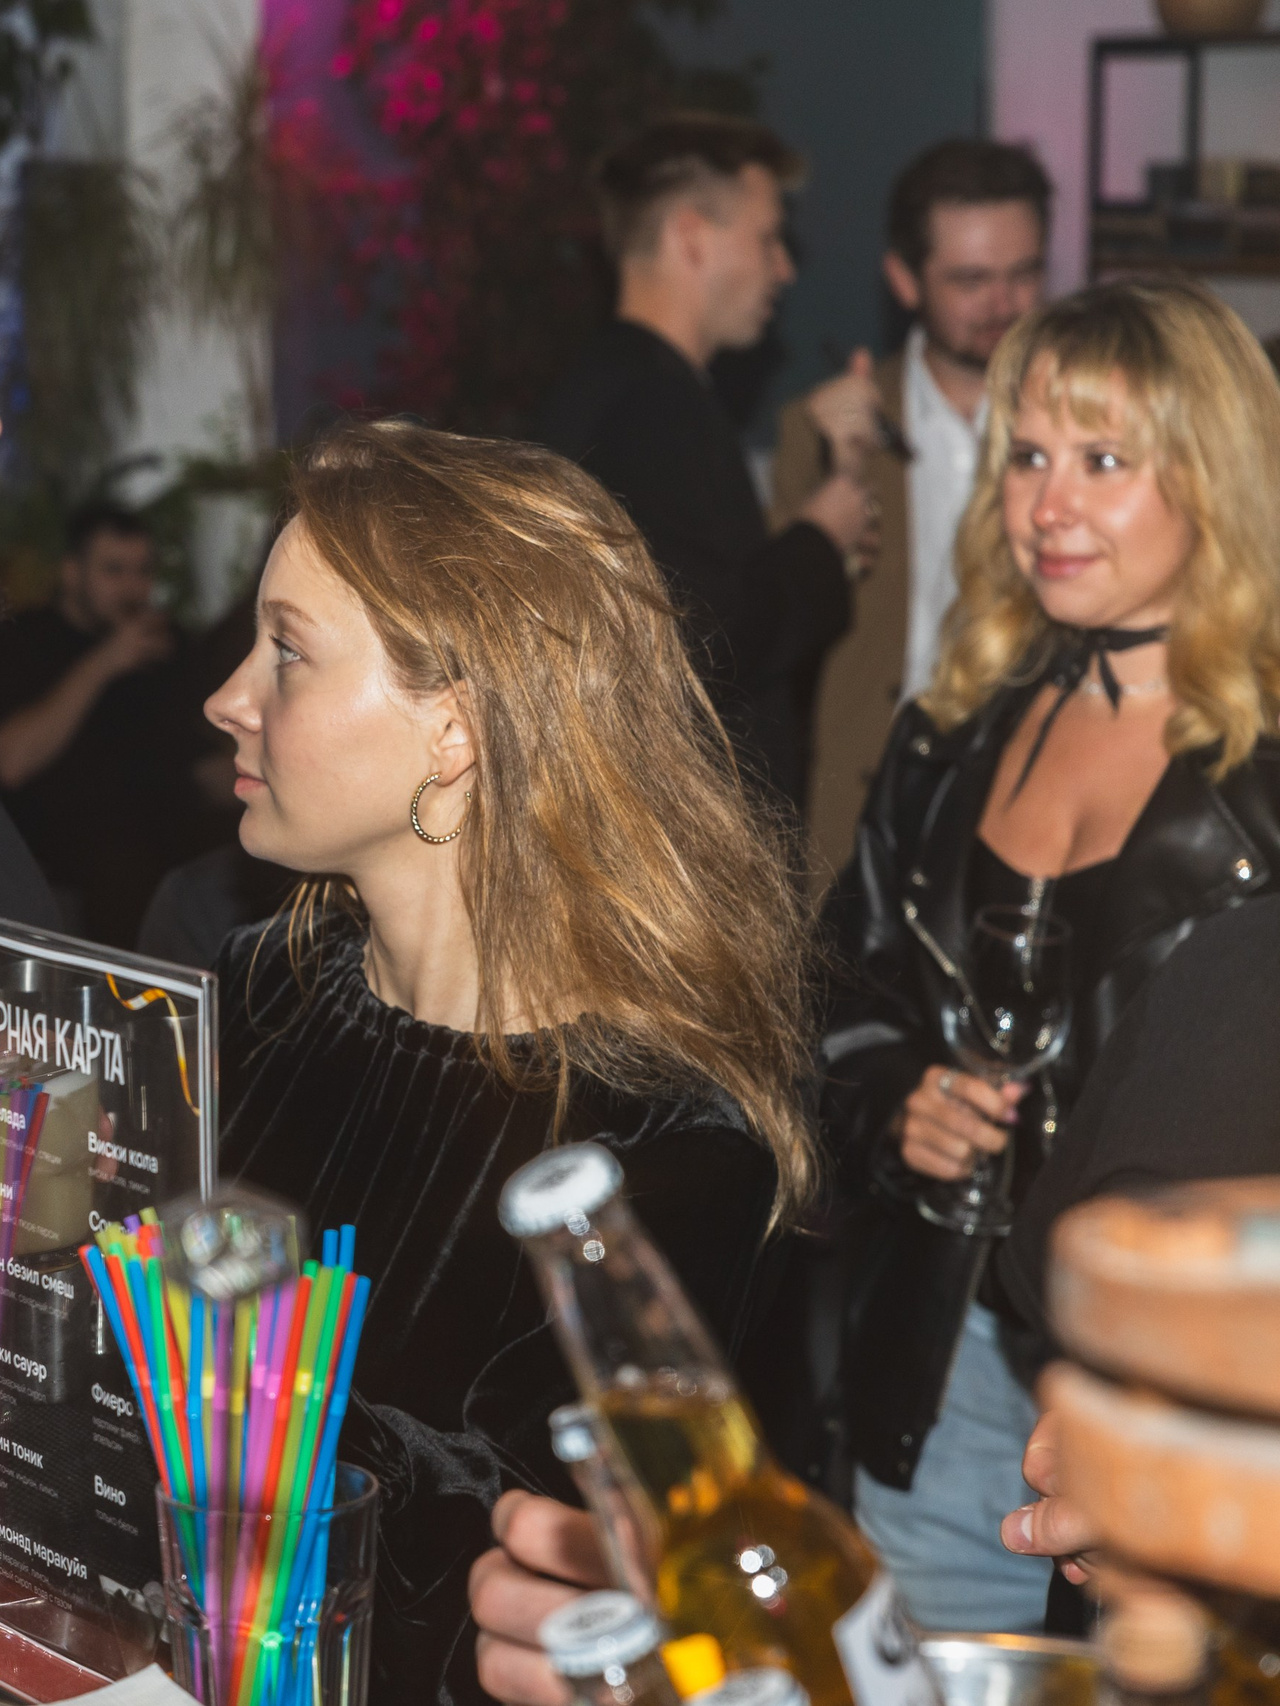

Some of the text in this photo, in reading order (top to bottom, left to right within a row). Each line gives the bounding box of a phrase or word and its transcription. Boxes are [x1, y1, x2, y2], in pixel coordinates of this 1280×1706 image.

[55, 1017, 125, 1086] КАРТА
[87, 1130, 127, 1163] Виски
[128, 1149, 159, 1174] кола
[6, 1257, 40, 1286] безил
[41, 1274, 75, 1300] смеш
[13, 1354, 48, 1383] сауэр
[91, 1382, 134, 1418] Фиеро
[11, 1442, 44, 1470] тоник
[94, 1474, 127, 1507] Вино
[33, 1541, 88, 1579] маракуйя
